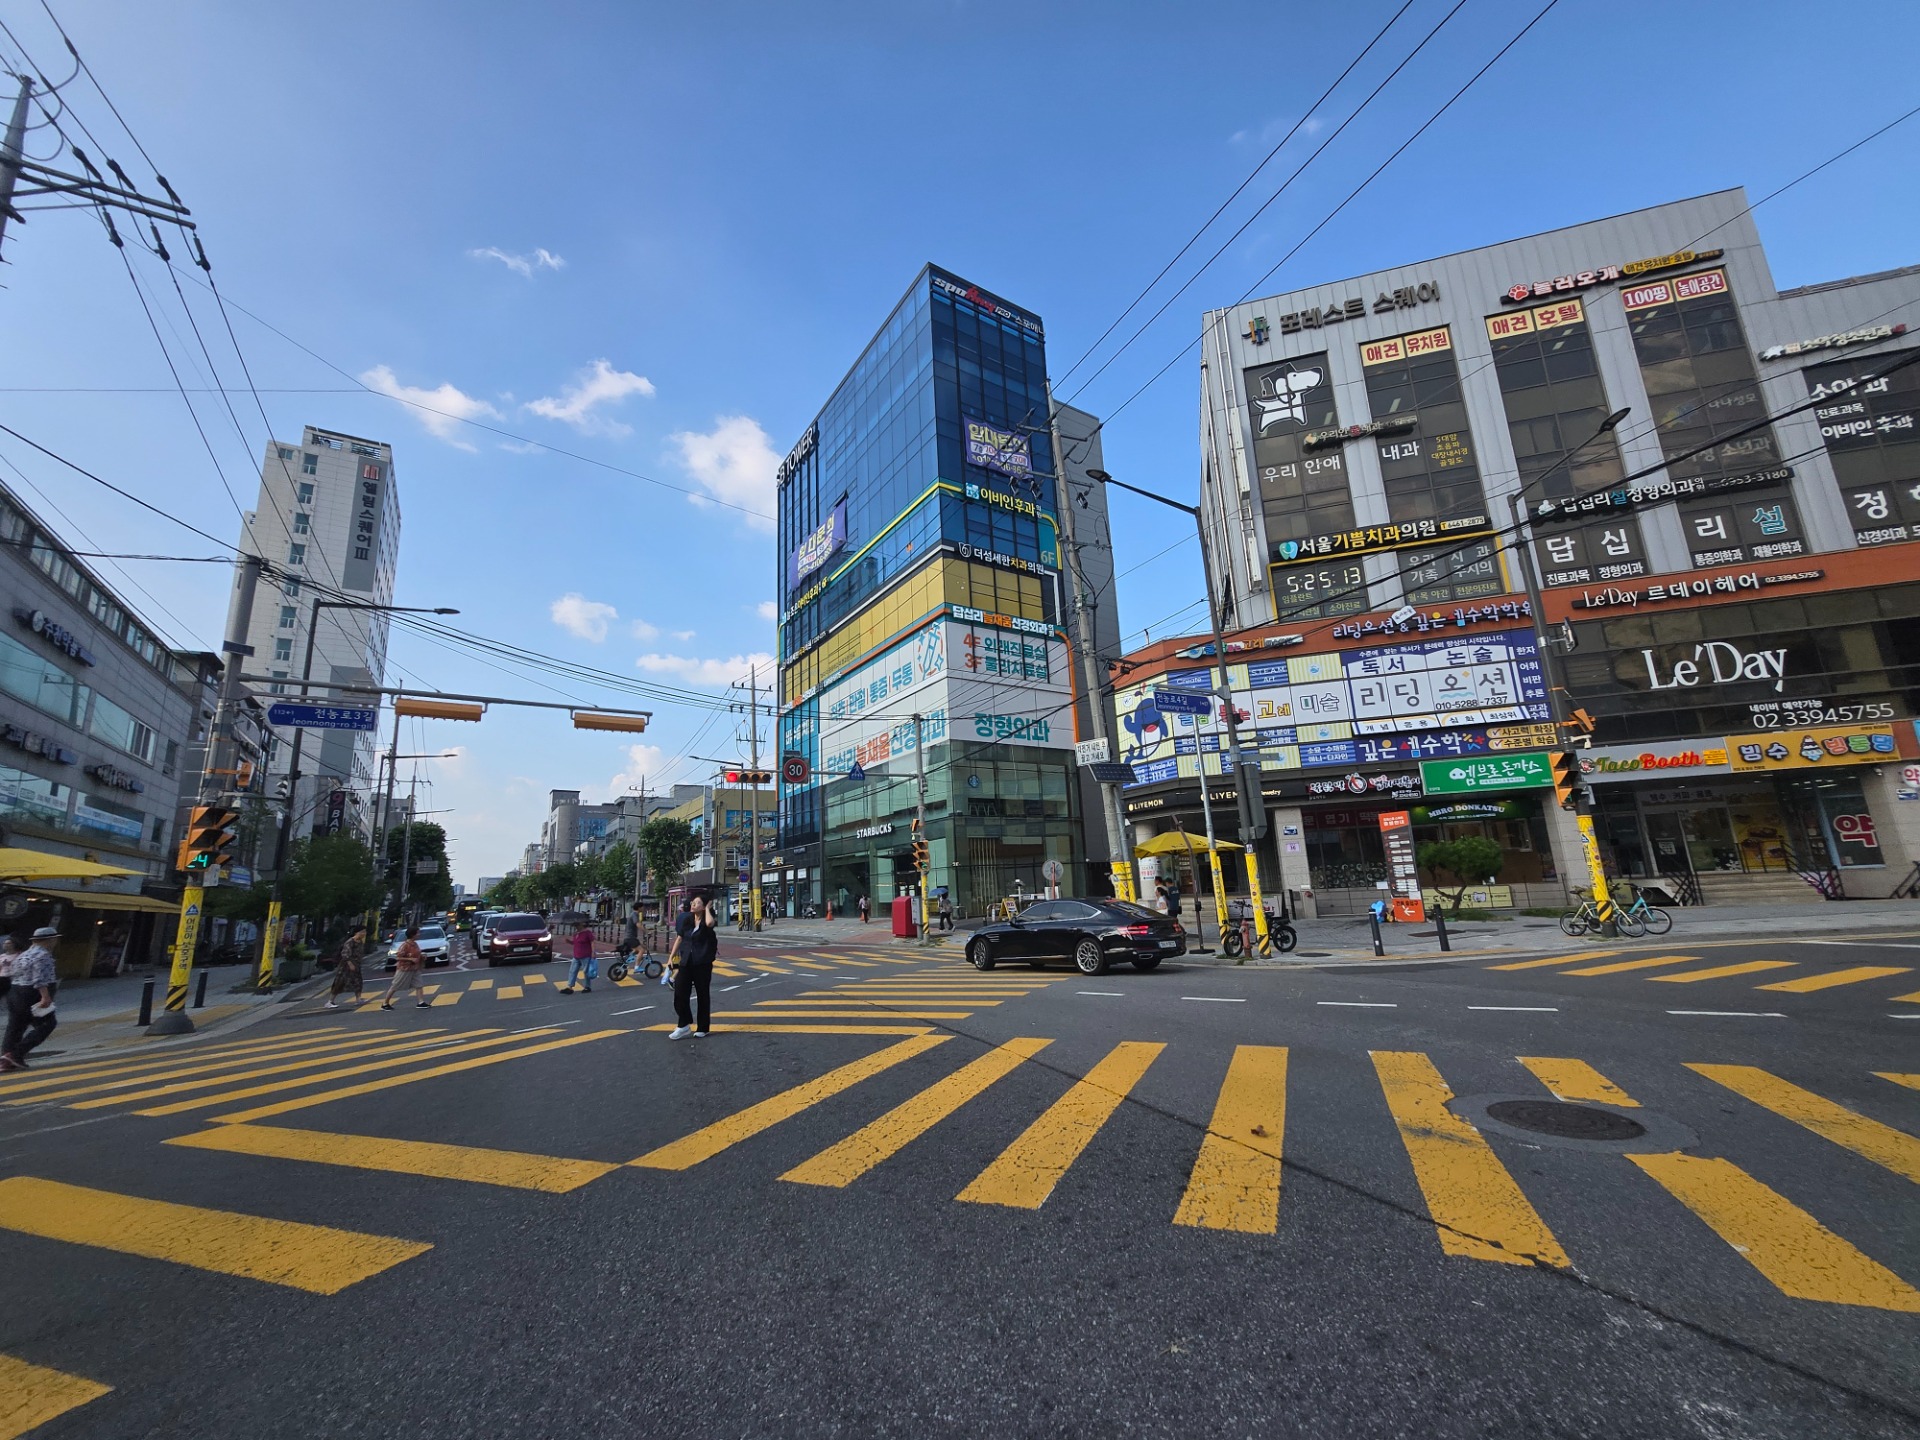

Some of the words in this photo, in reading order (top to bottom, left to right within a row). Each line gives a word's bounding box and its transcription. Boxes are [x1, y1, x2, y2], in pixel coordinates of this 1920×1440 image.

[1533, 265, 1619, 296] 놀러오개
[1625, 285, 1667, 307] 100평
[1678, 273, 1722, 296] 놀이공간
[1280, 297, 1366, 334] 포레스트
[1373, 280, 1440, 314] 스퀘어
[1492, 315, 1528, 335] 애견
[1538, 303, 1579, 326] 호텔
[1366, 342, 1400, 361] 애견
[1407, 332, 1448, 353] 유치원
[1817, 402, 1865, 419] 진료과목
[786, 426, 813, 472] TOWER
[1263, 463, 1297, 483] 우리
[1304, 454, 1341, 475] 안애
[1382, 441, 1419, 460] 내과
[980, 487, 1035, 517] 이비인후과
[1300, 519, 1437, 555] 서울기쁨치과의원
[974, 548, 1045, 575] 더섬세한치과의원
[1040, 550, 1055, 565] 6F
[1546, 569, 1591, 586] 진료과목
[1599, 562, 1643, 579] 정형외과
[1694, 548, 1743, 566] 통증의학과
[1752, 540, 1802, 558] 재활의학과
[1857, 527, 1908, 544] 신경외과
[1411, 568, 1438, 583] 가족
[1430, 589, 1449, 598] 야간
[1455, 582, 1498, 595] 전문의진료
[1282, 592, 1314, 604] 임플란트
[1329, 601, 1361, 614] 소아진료
[1333, 618, 1395, 640] 리딩오션
[1400, 622, 1409, 633] &
[963, 633, 981, 648] 4F
[984, 637, 1046, 661] 외래진료실
[1516, 646, 1535, 655] 한자
[964, 653, 982, 669] 3F
[985, 656, 1048, 679] 물리치료실
[1362, 656, 1407, 674] 독서
[1446, 646, 1493, 666] 논술
[1520, 661, 1539, 671] 어휘
[1641, 641, 1788, 693] Le'Day
[1522, 674, 1541, 685] 비판
[869, 676, 888, 703] 통증
[1525, 688, 1545, 698] 추론
[1156, 694, 1188, 705] 전농로4길
[1257, 700, 1292, 719] 고래
[1300, 693, 1339, 713] 미술
[1528, 703, 1547, 712] 교과
[1749, 702, 1779, 713] 네이버
[1782, 700, 1823, 711] 예약가능
[315, 708, 373, 722] 전농로3길
[1489, 710, 1517, 721] 최상위
[1531, 711, 1549, 720] 수학
[1753, 713, 1781, 728] 02
[1784, 702, 1895, 727] 33945755
[290, 717, 350, 728] Jeonnong-ro
[352, 721, 372, 730] 3-gil
[974, 712, 1050, 742] 정형외과
[1503, 726, 1530, 736] 사고력
[1503, 737, 1532, 747] 수준별
[1536, 734, 1556, 745] 학습
[789, 765, 803, 776] 30
[1465, 763, 1502, 786] 엠브로
[1502, 759, 1543, 776] 돈까스
[1134, 799, 1163, 810] LIYEMON
[1455, 803, 1505, 813] DONKATSU
[856, 823, 892, 839] STARBUCKS
[1833, 814, 1878, 848] 약
